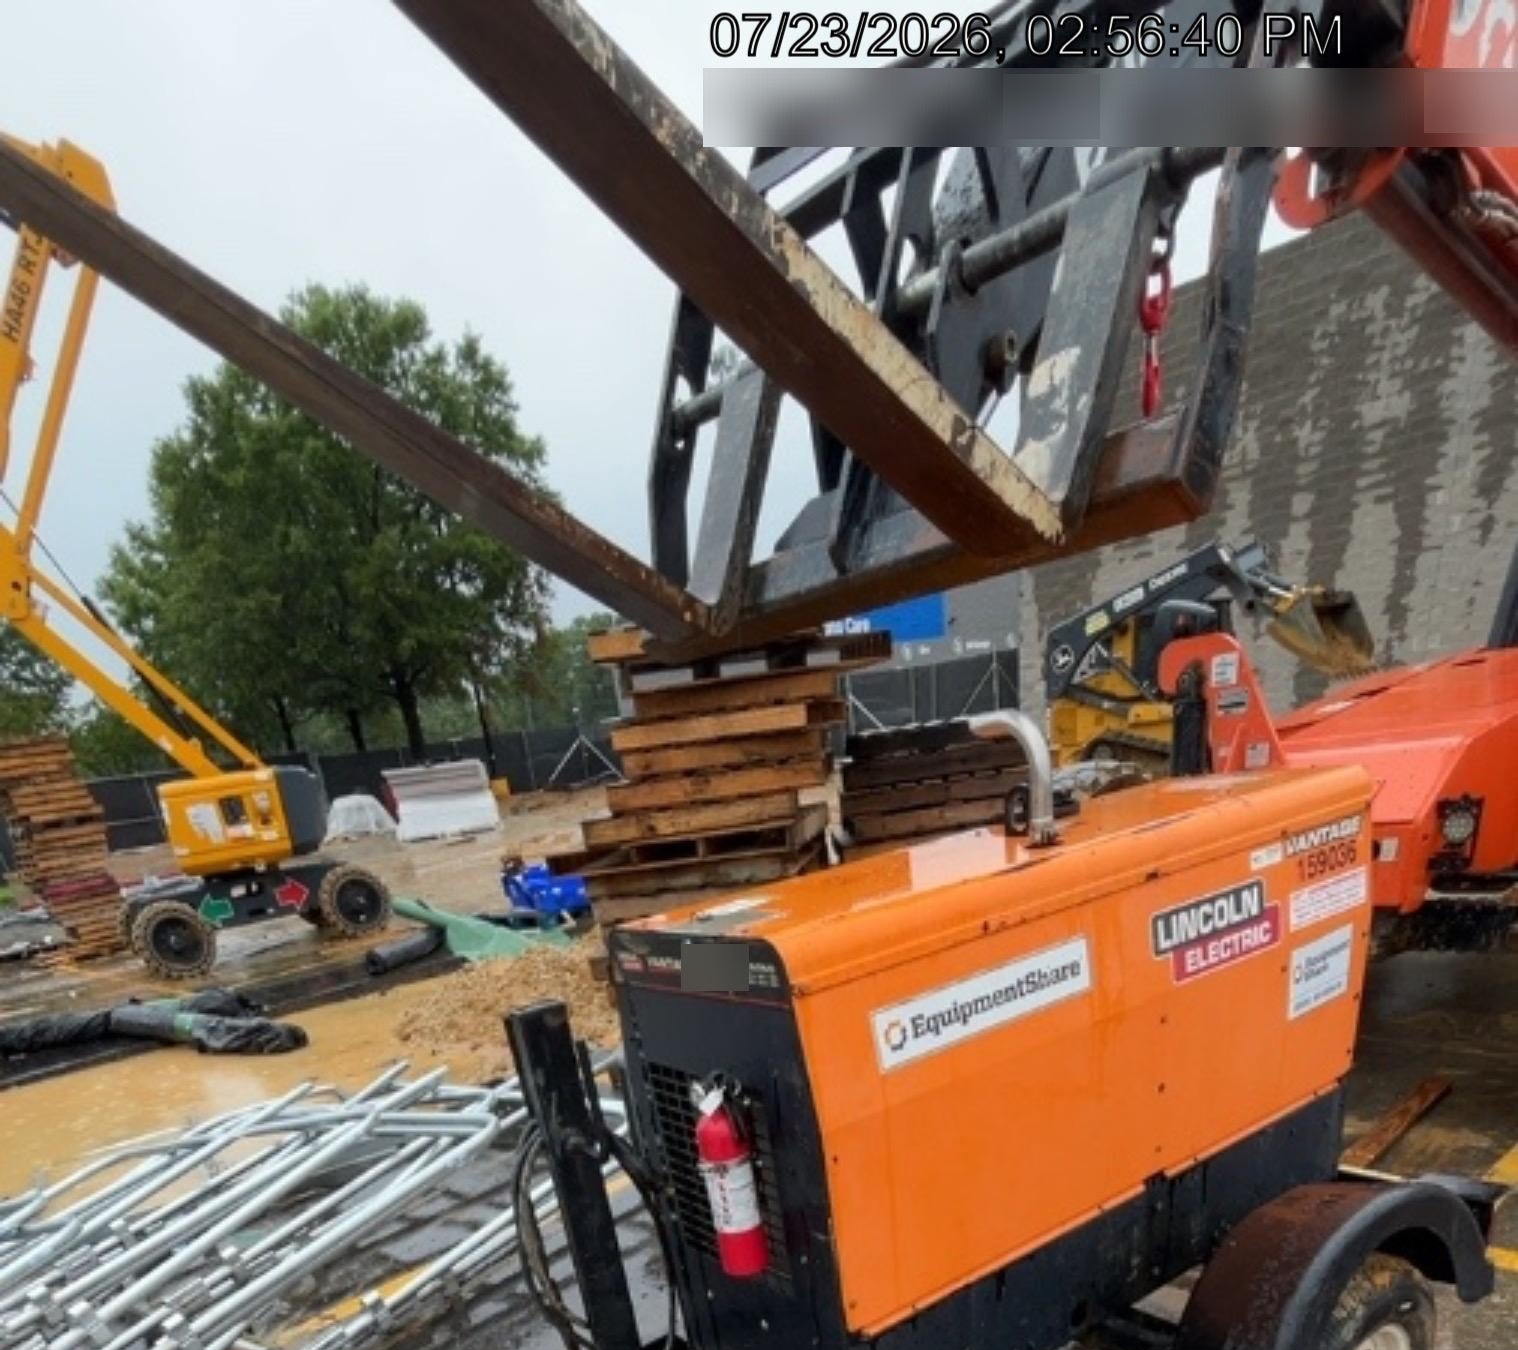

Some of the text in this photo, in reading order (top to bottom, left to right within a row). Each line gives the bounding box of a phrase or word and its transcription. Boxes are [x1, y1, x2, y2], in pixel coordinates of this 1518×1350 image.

[1286, 815, 1361, 856] VANTAGE
[1157, 885, 1260, 951] LINCOLN
[1184, 920, 1272, 973] ELECTRIC
[911, 959, 1082, 1040] EquipmentShare
